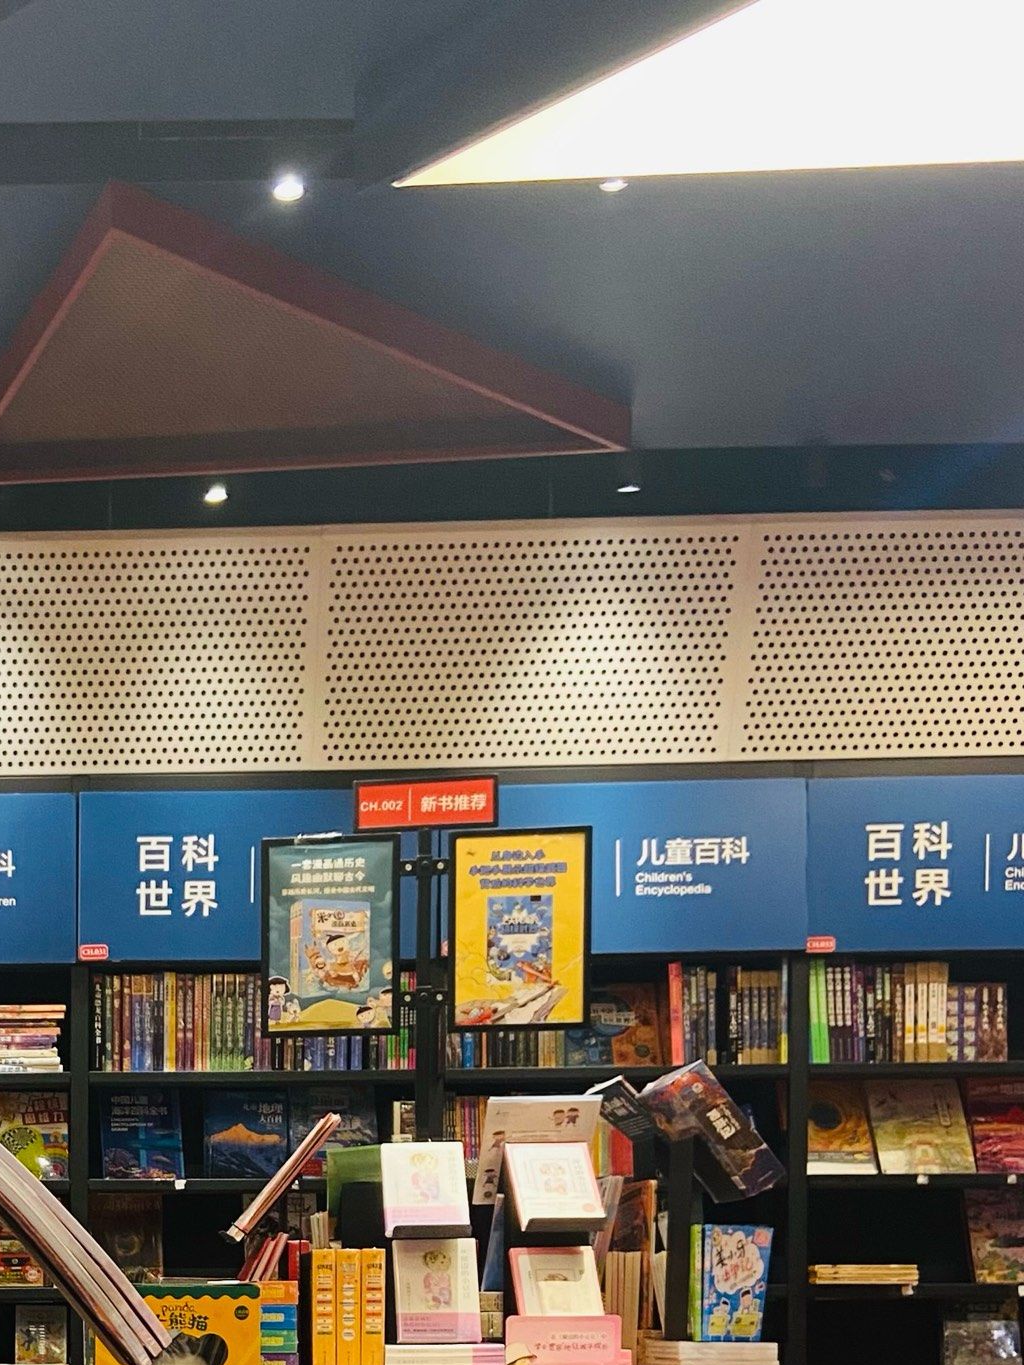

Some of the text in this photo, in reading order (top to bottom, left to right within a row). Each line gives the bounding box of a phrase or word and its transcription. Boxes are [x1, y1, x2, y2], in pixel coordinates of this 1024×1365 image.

[360, 800, 404, 812] CH.002
[420, 792, 487, 813] 新书推荐
[136, 834, 219, 873] 百科
[636, 836, 750, 866] 儿童百科
[865, 821, 953, 862] 百科
[635, 871, 693, 883] Children's
[865, 868, 953, 906] 世界
[136, 879, 219, 917] 世界
[635, 884, 712, 896] Encyclopedia
[161, 1302, 196, 1314] panda
